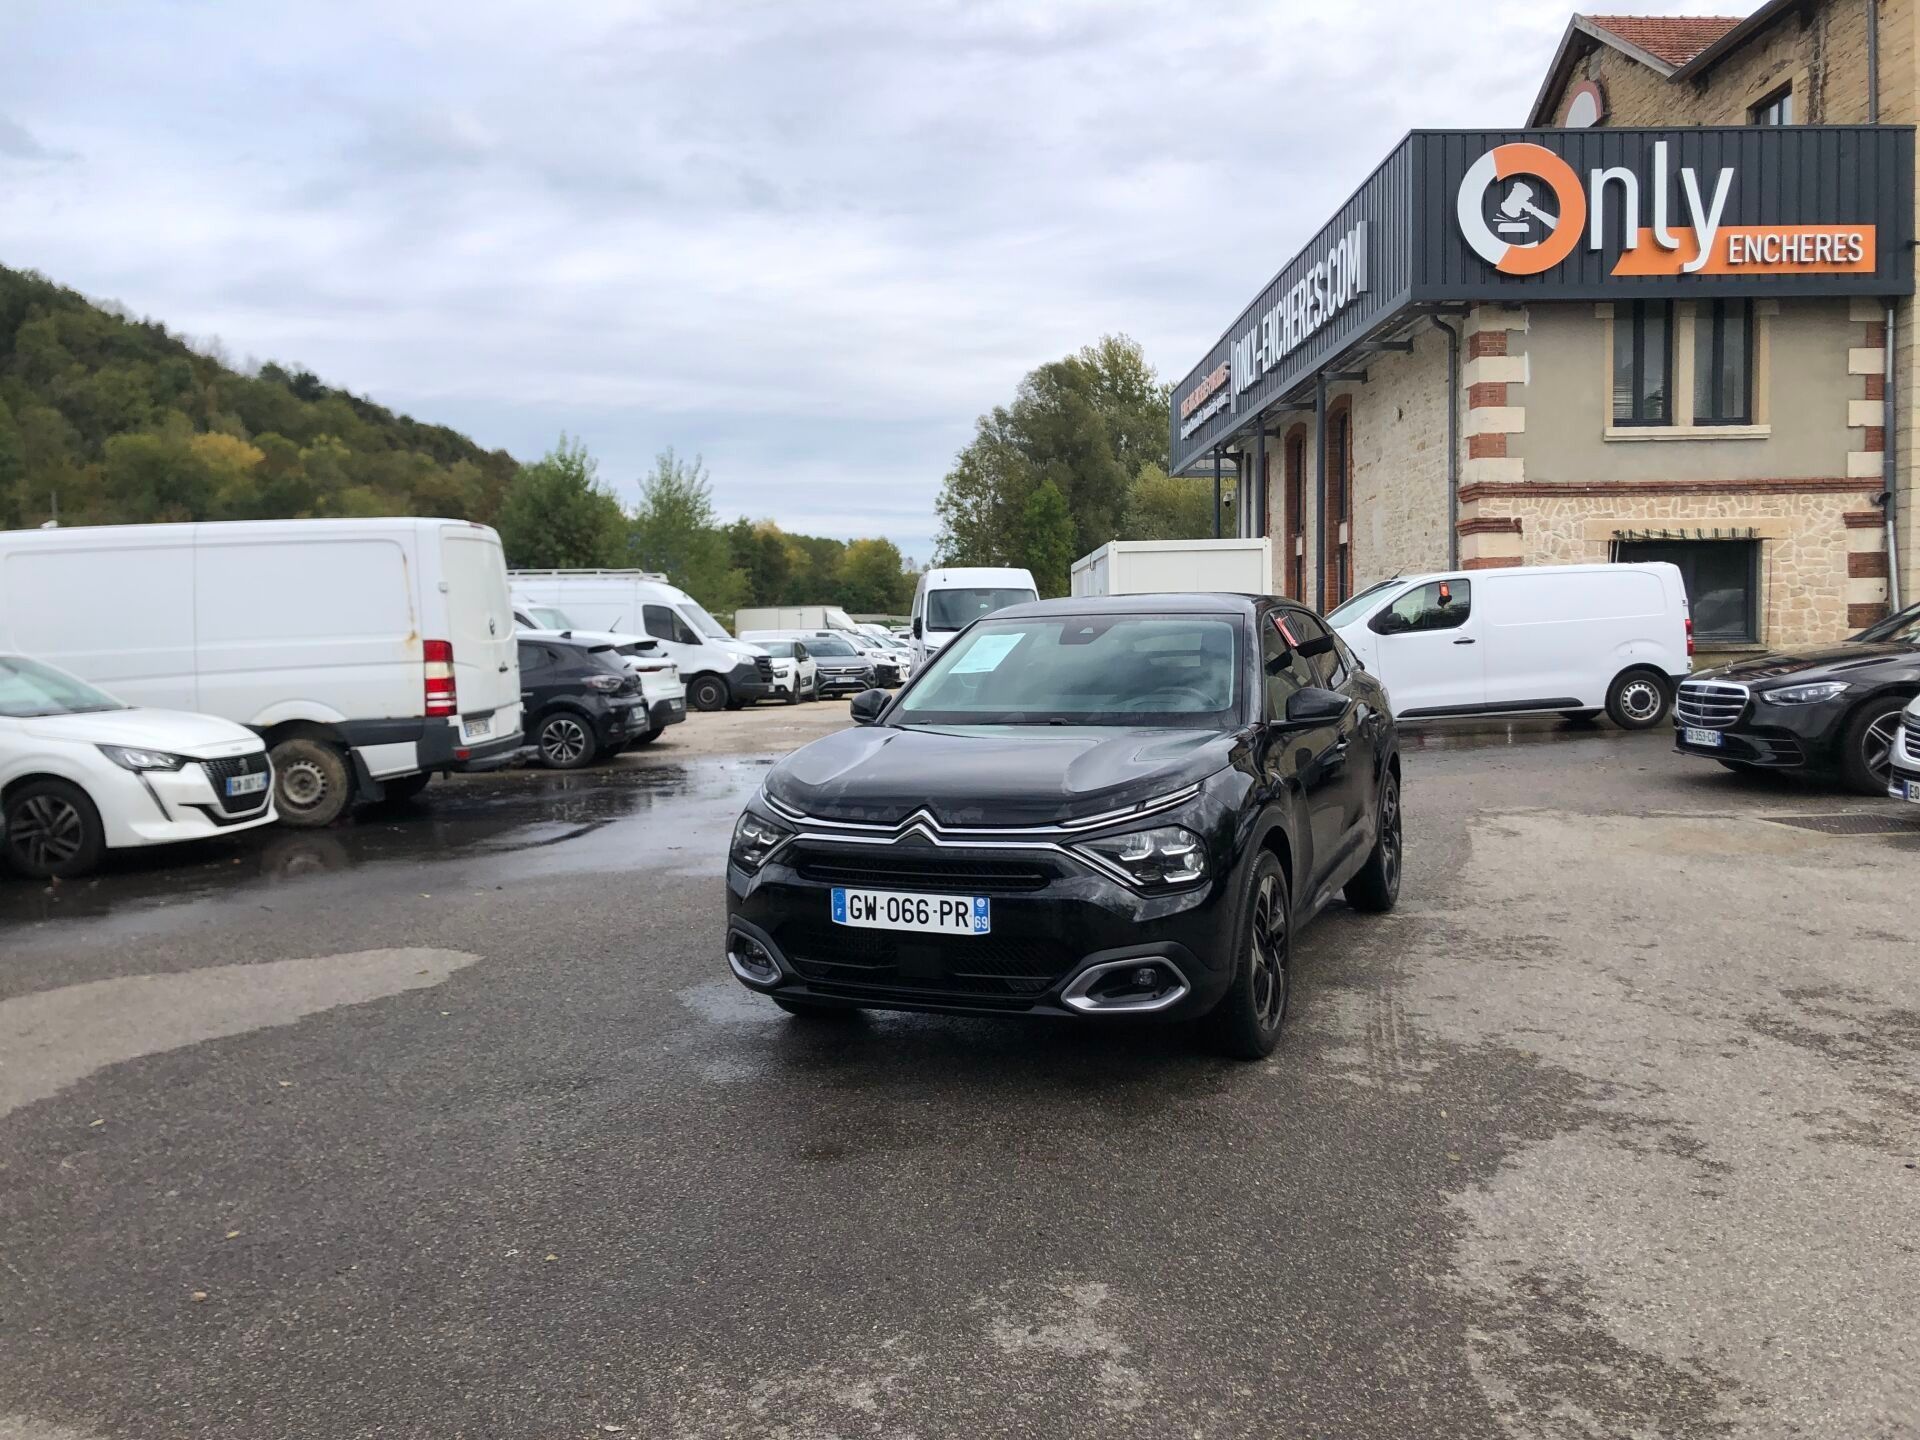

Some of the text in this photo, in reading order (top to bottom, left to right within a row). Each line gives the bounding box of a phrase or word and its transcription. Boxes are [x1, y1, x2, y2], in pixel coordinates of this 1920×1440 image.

[1457, 141, 1735, 274] Only
[1728, 232, 1864, 265] ENCHERES
[1236, 221, 1366, 396] ONLY-ENCHERES.COM
[836, 907, 843, 917] F
[849, 894, 969, 928] GW-066-PR
[974, 915, 988, 930] 69
